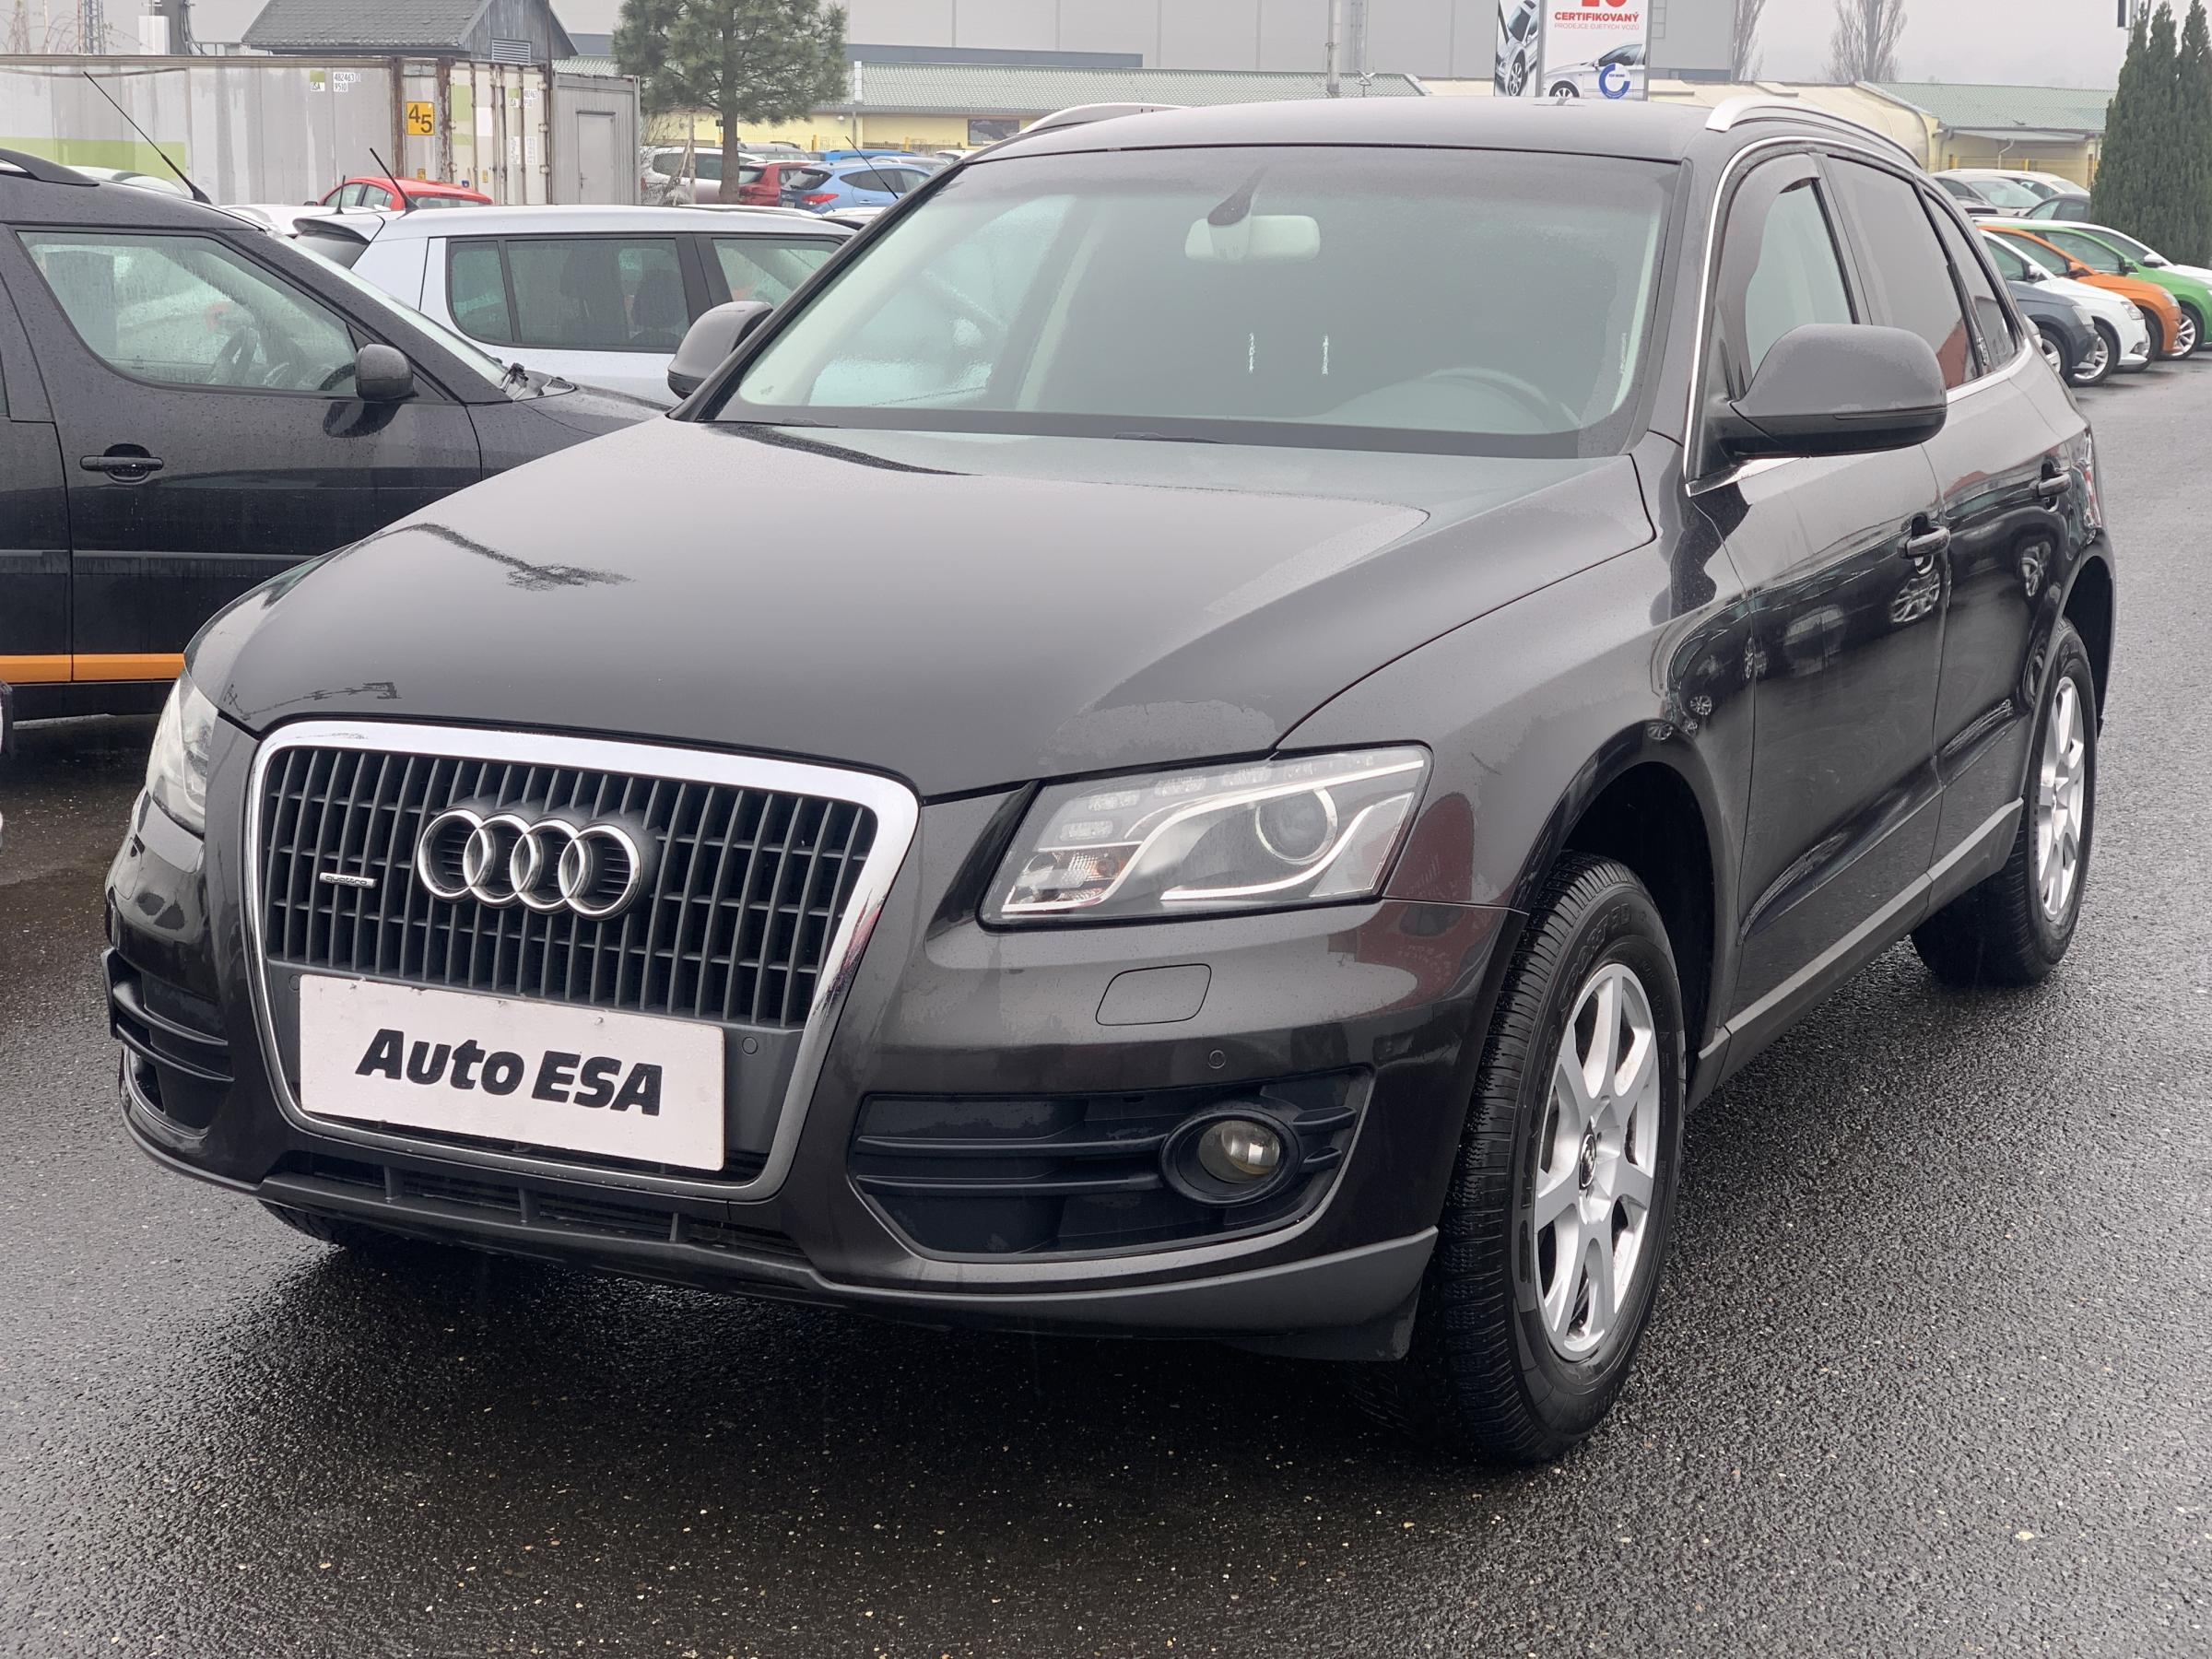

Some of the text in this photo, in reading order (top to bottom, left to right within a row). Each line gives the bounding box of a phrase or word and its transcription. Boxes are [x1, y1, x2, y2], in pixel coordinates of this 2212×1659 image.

[1554, 11, 1639, 22] CERTIFIKOVANÝ
[325, 875, 368, 886] quattro
[355, 1029, 663, 1116] Auto ESA
